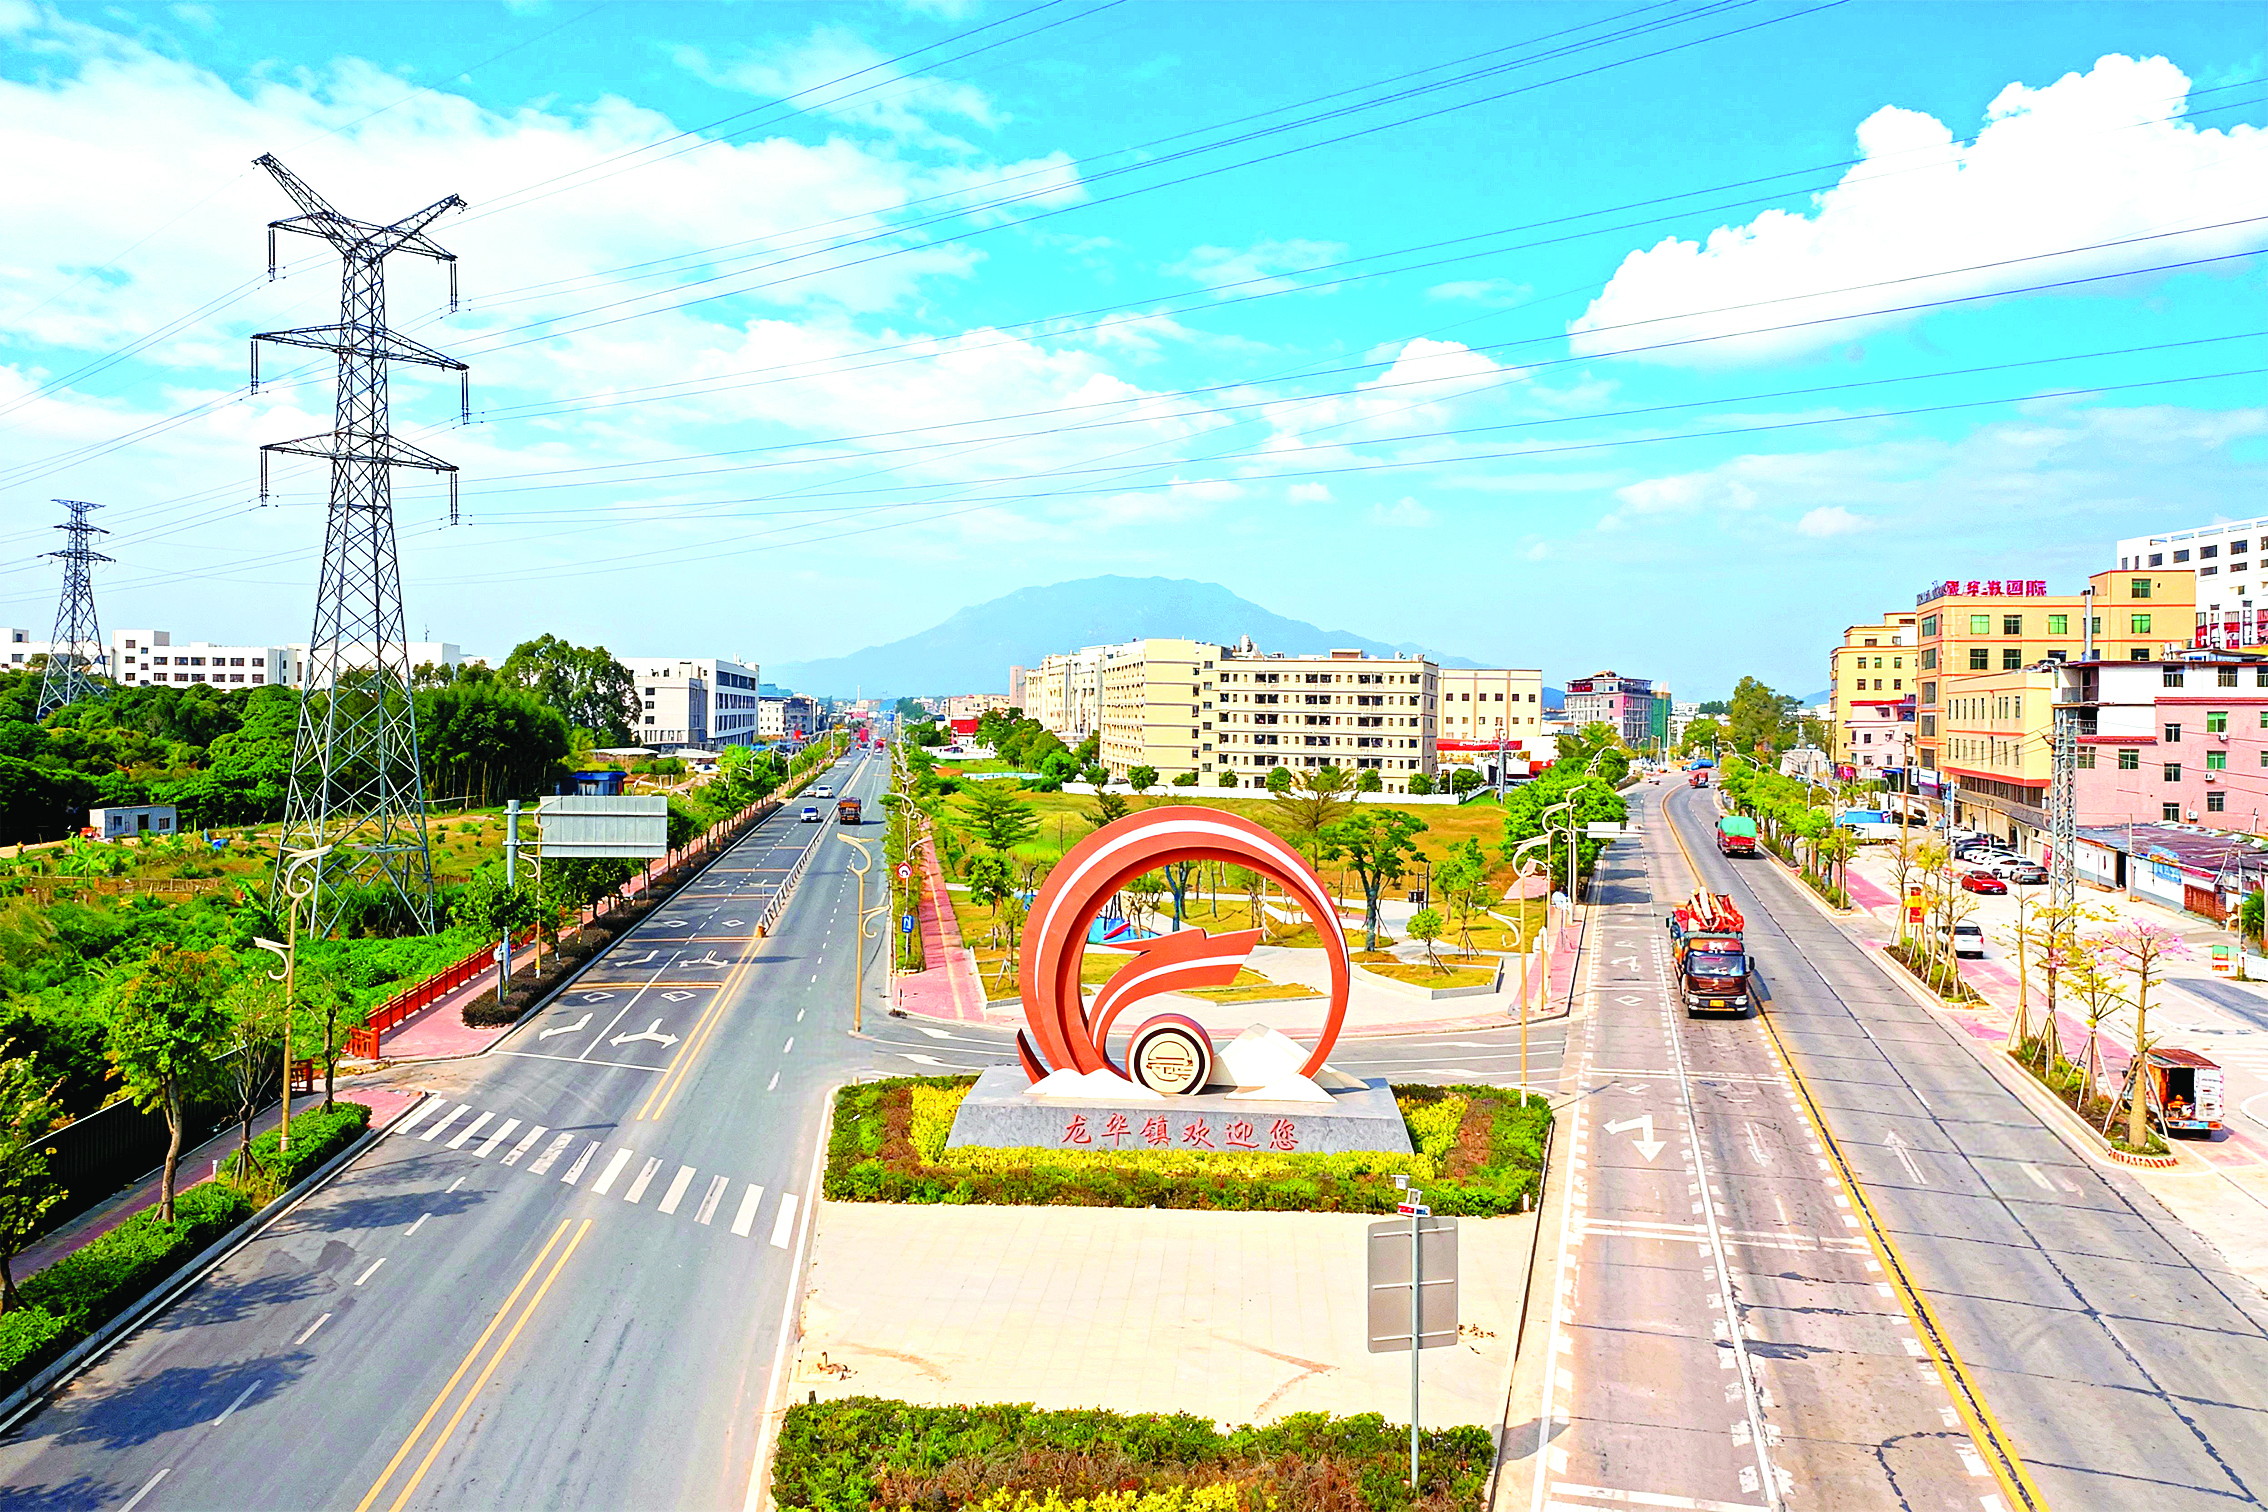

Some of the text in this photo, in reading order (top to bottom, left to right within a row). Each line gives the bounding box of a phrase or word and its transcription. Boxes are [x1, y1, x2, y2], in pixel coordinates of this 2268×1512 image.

[1061, 1113, 1299, 1150] 龙华镇欢迎您
